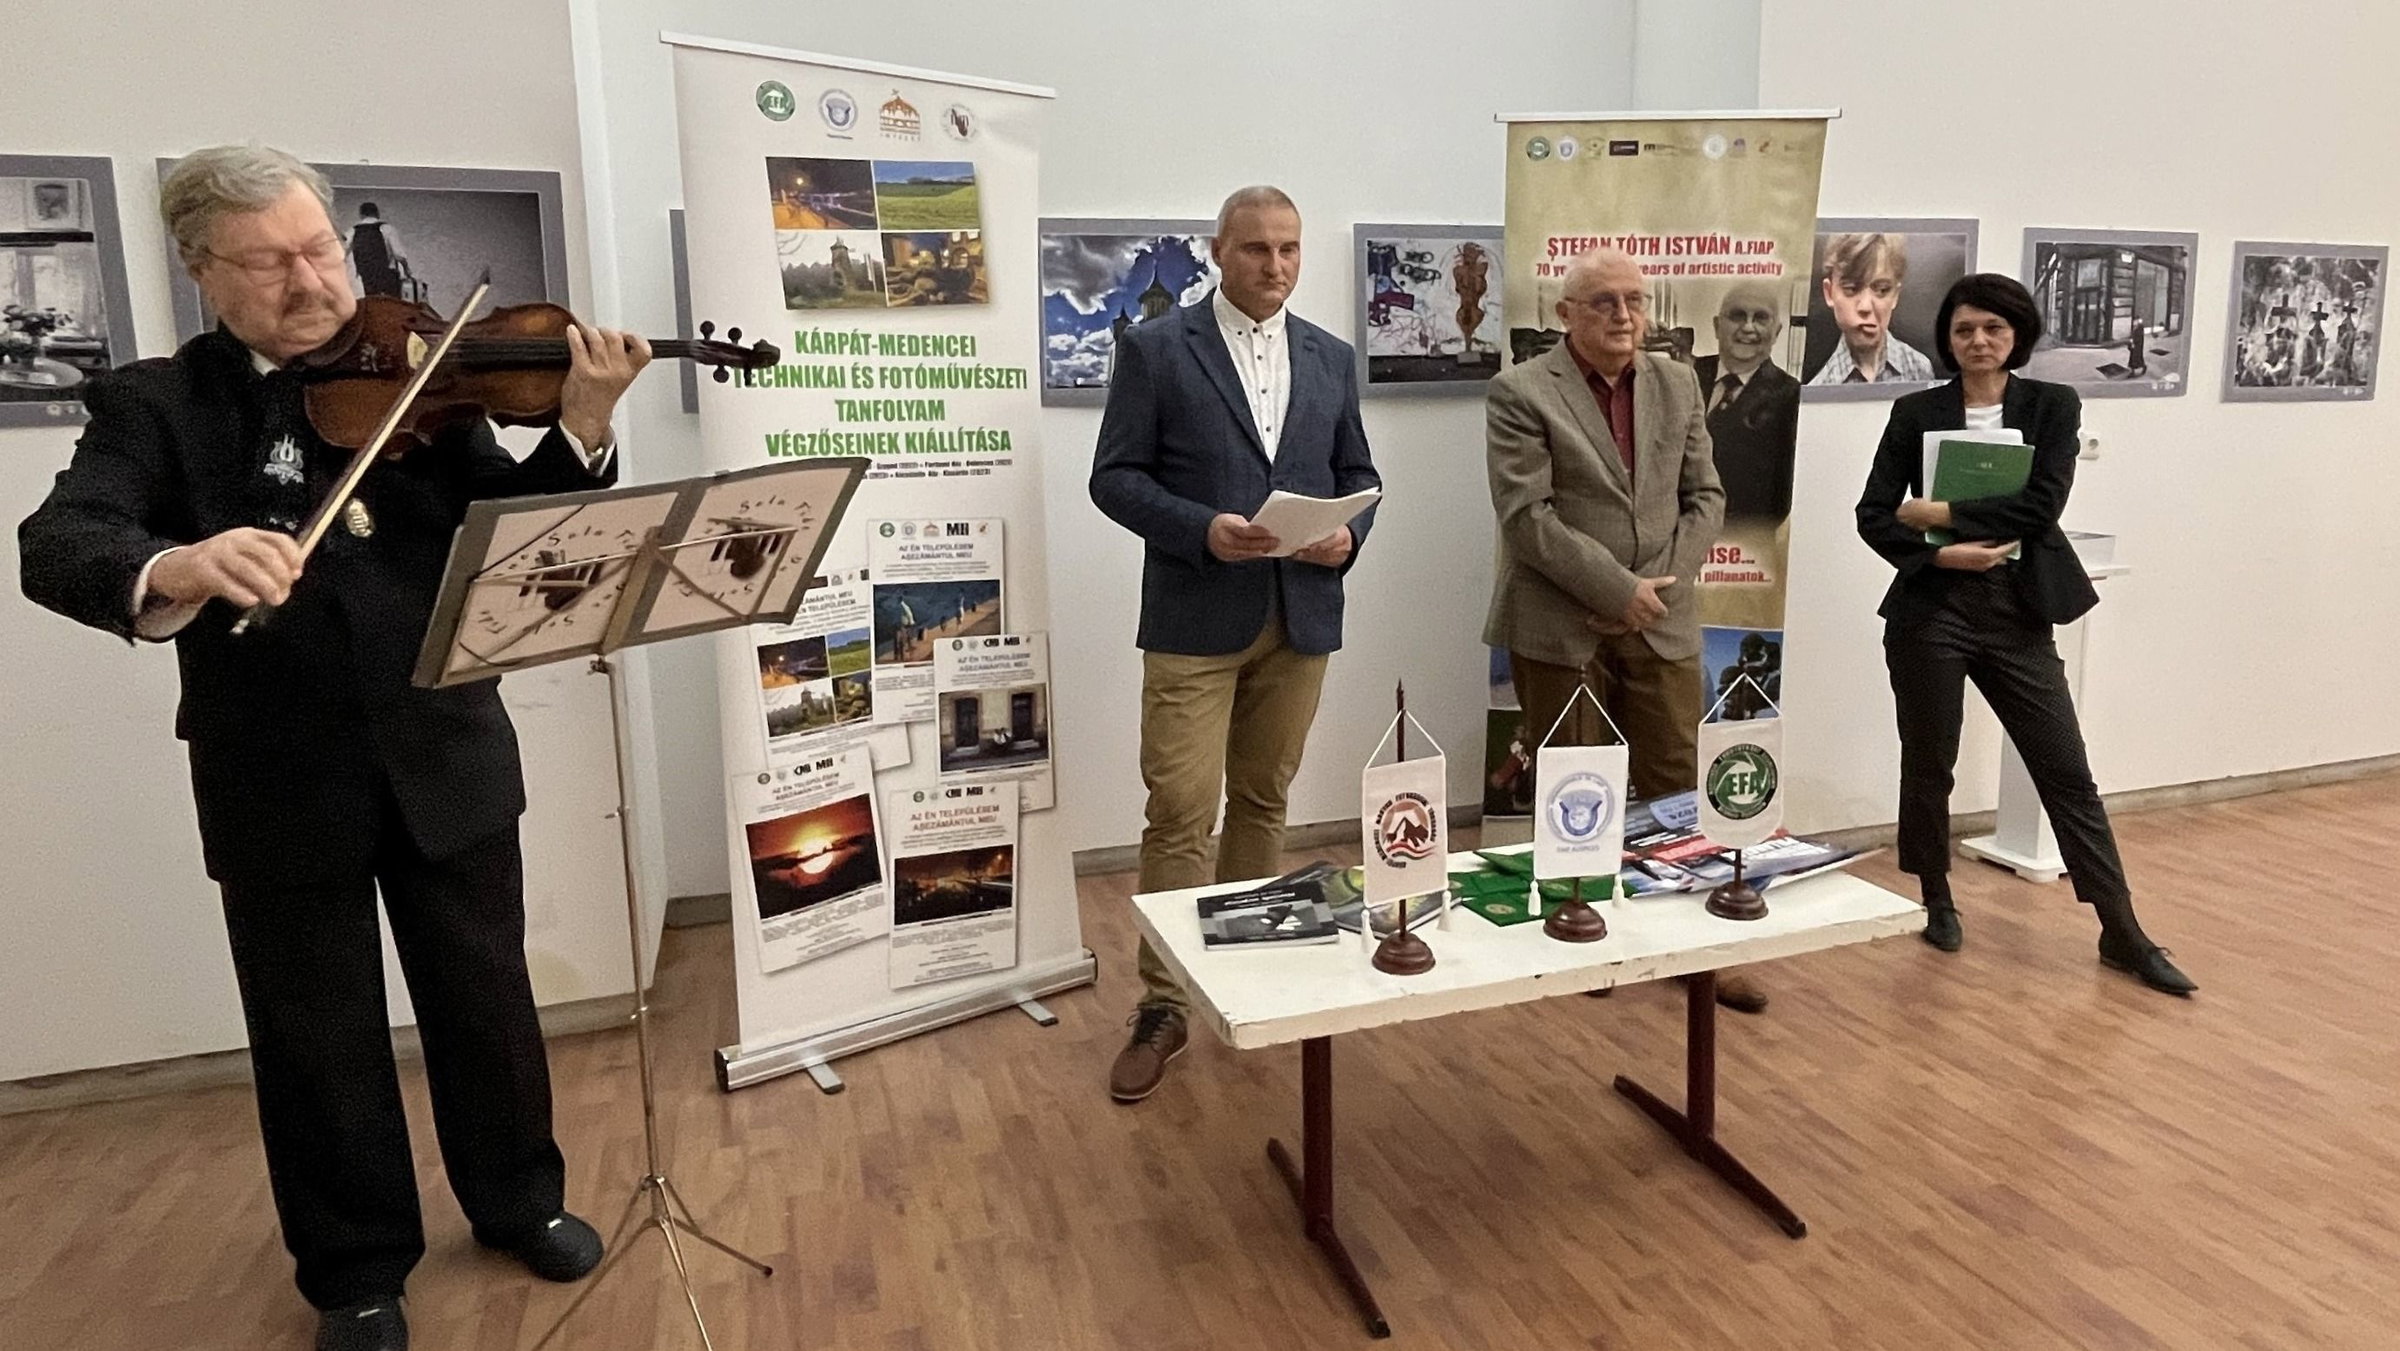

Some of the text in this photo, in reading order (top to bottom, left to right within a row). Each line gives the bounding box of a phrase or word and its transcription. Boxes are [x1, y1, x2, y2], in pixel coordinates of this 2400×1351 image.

[1616, 233, 1660, 256] TÓTH
[1666, 232, 1730, 256] ISTVÁN
[1735, 241, 1775, 255] A.FIAP
[1536, 263, 1550, 276] 70
[1639, 264, 1669, 276] ears
[1673, 262, 1685, 276] of
[1688, 262, 1734, 275] artistic
[1737, 262, 1782, 277] activity
[795, 327, 976, 357] KÁRPÁT-MEDENCEI
[851, 361, 874, 388] ÉS
[880, 362, 1027, 389] FOTÓMŰVÉSZETI
[835, 399, 945, 422] TANFOLYAM
[766, 426, 1012, 456] VÉGZŐSEINEK KIÁLLÍTÁSA
